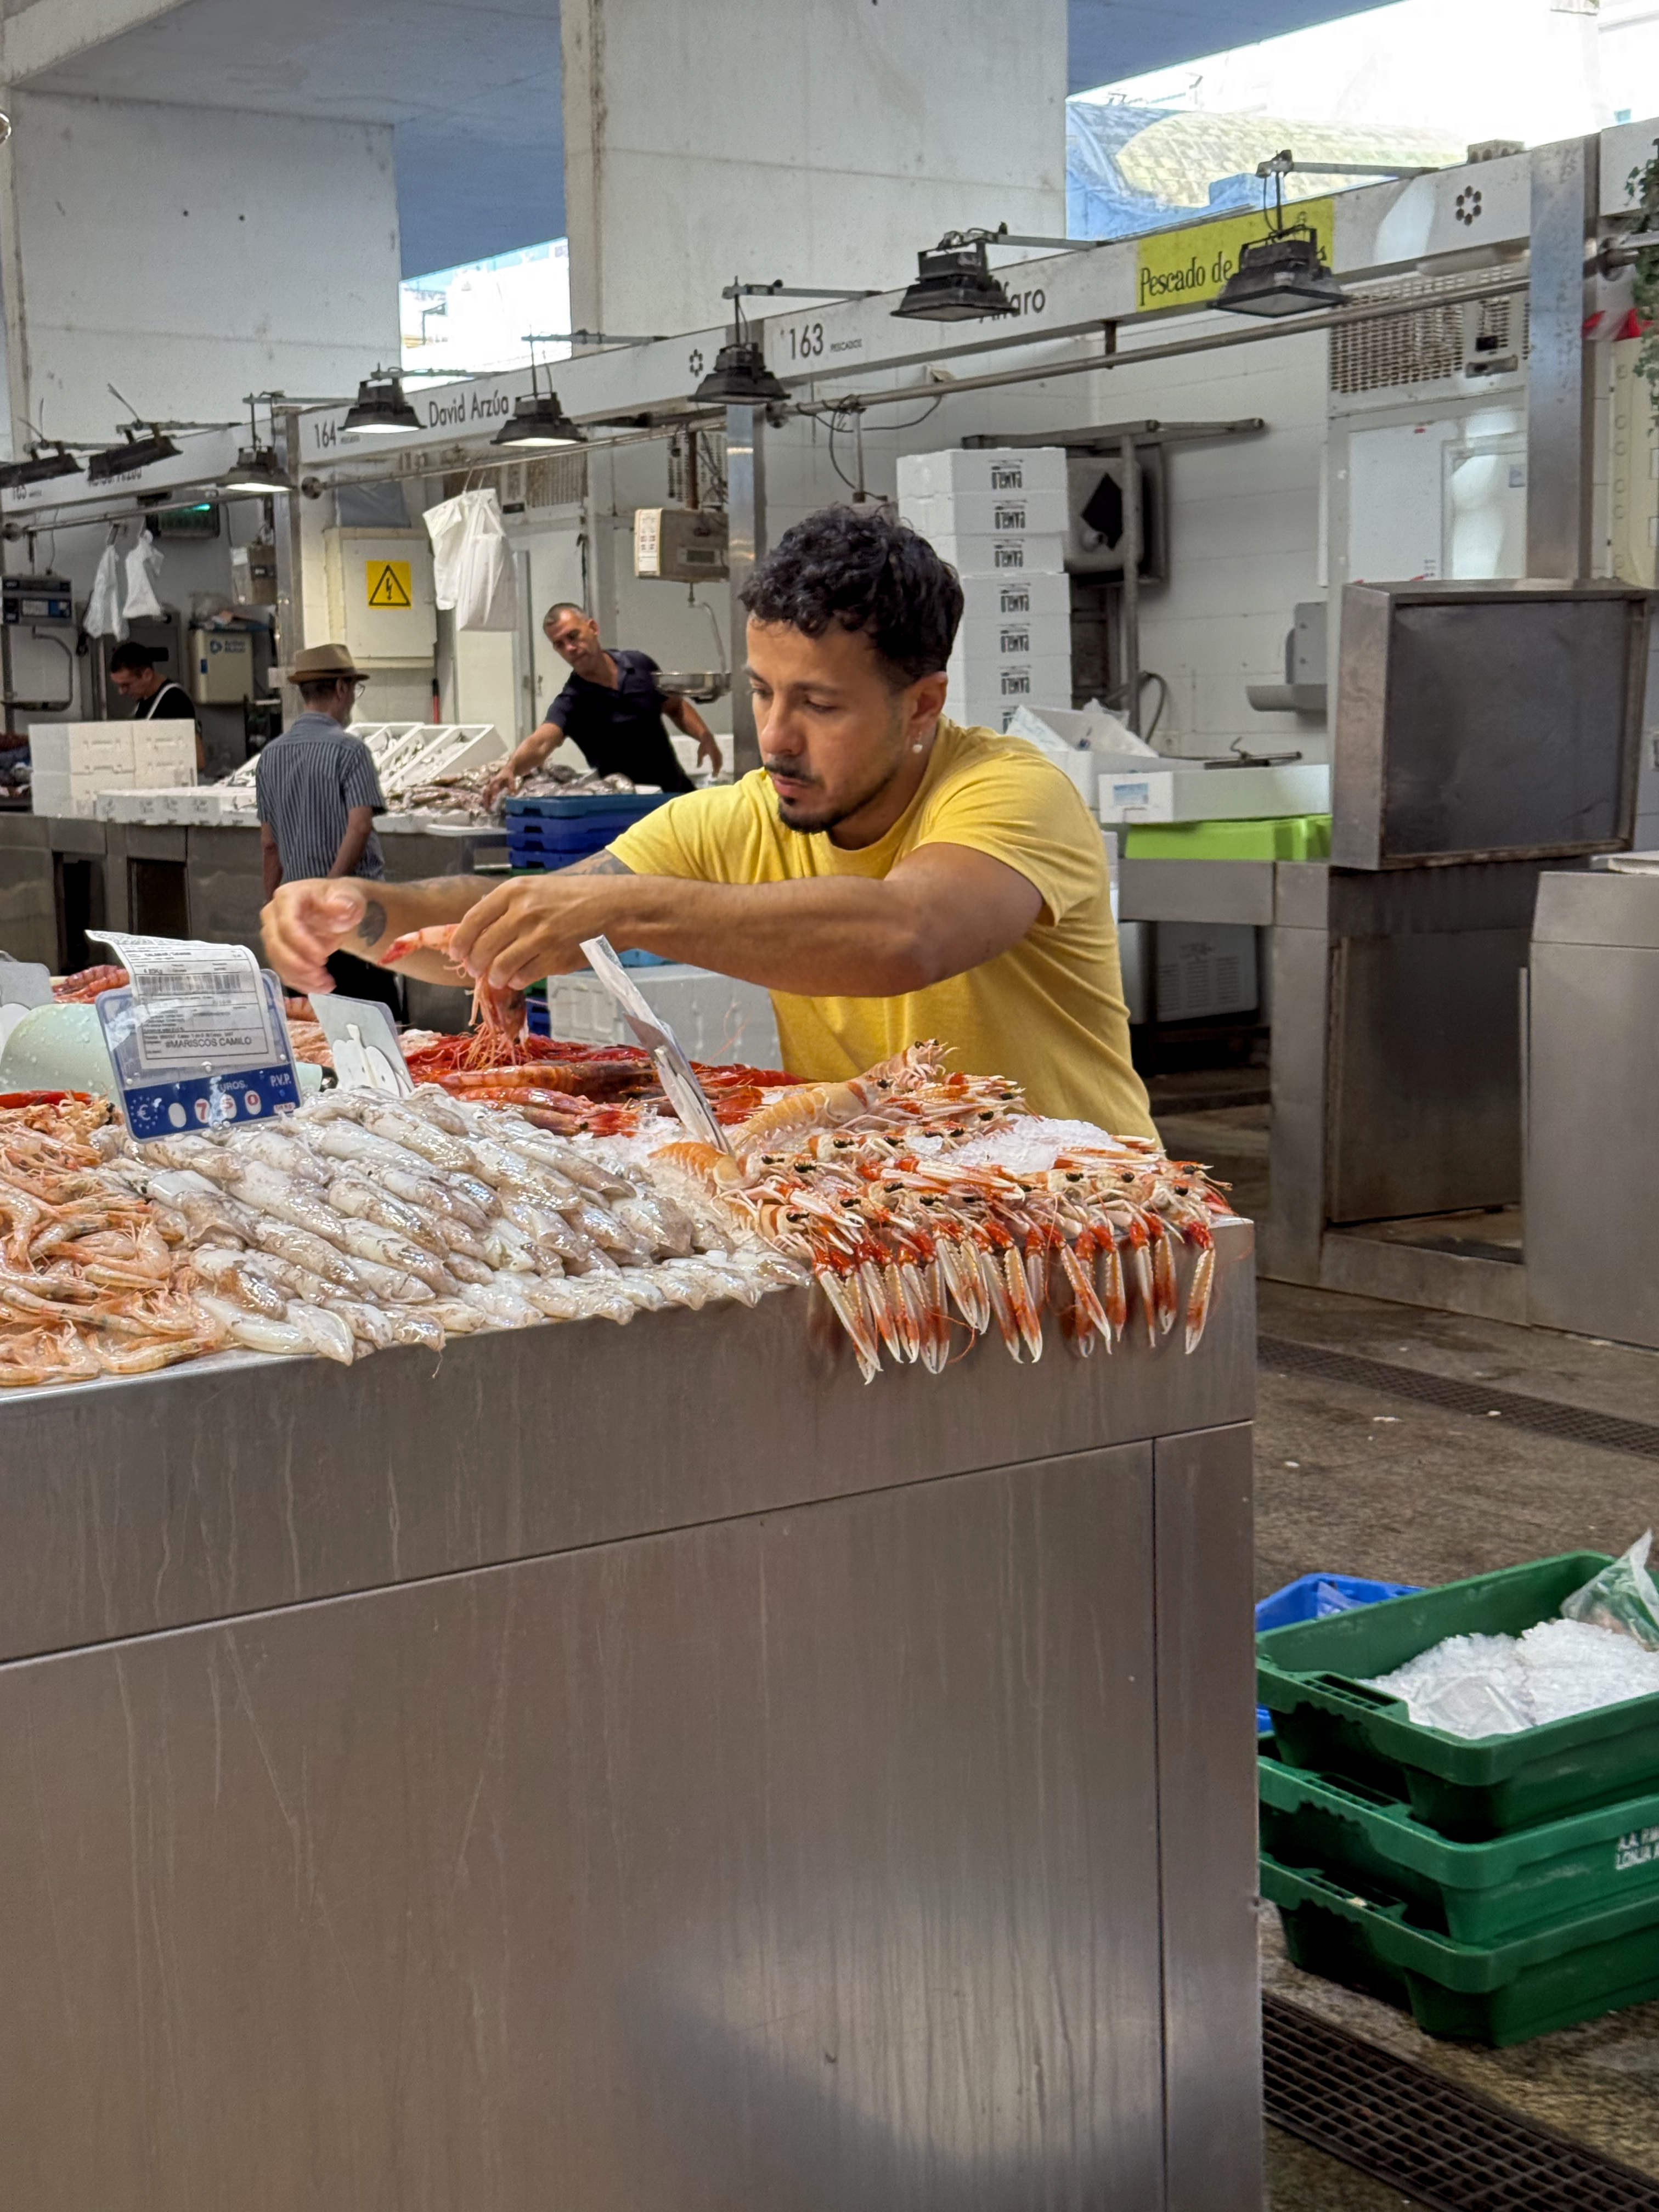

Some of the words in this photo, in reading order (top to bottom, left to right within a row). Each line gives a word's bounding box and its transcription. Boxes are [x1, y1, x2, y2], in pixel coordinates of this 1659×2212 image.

[1140, 256, 1206, 306] Pescado
[1211, 251, 1233, 284] de
[789, 323, 823, 360] 163
[429, 392, 466, 428] David
[471, 389, 509, 420] Arzúa
[314, 420, 336, 449] 164
[219, 1036, 252, 1046] CAMILO
[270, 1073, 292, 1087] P.V.P.
[196, 1102, 207, 1120] 7
[247, 1094, 259, 1106] 0
